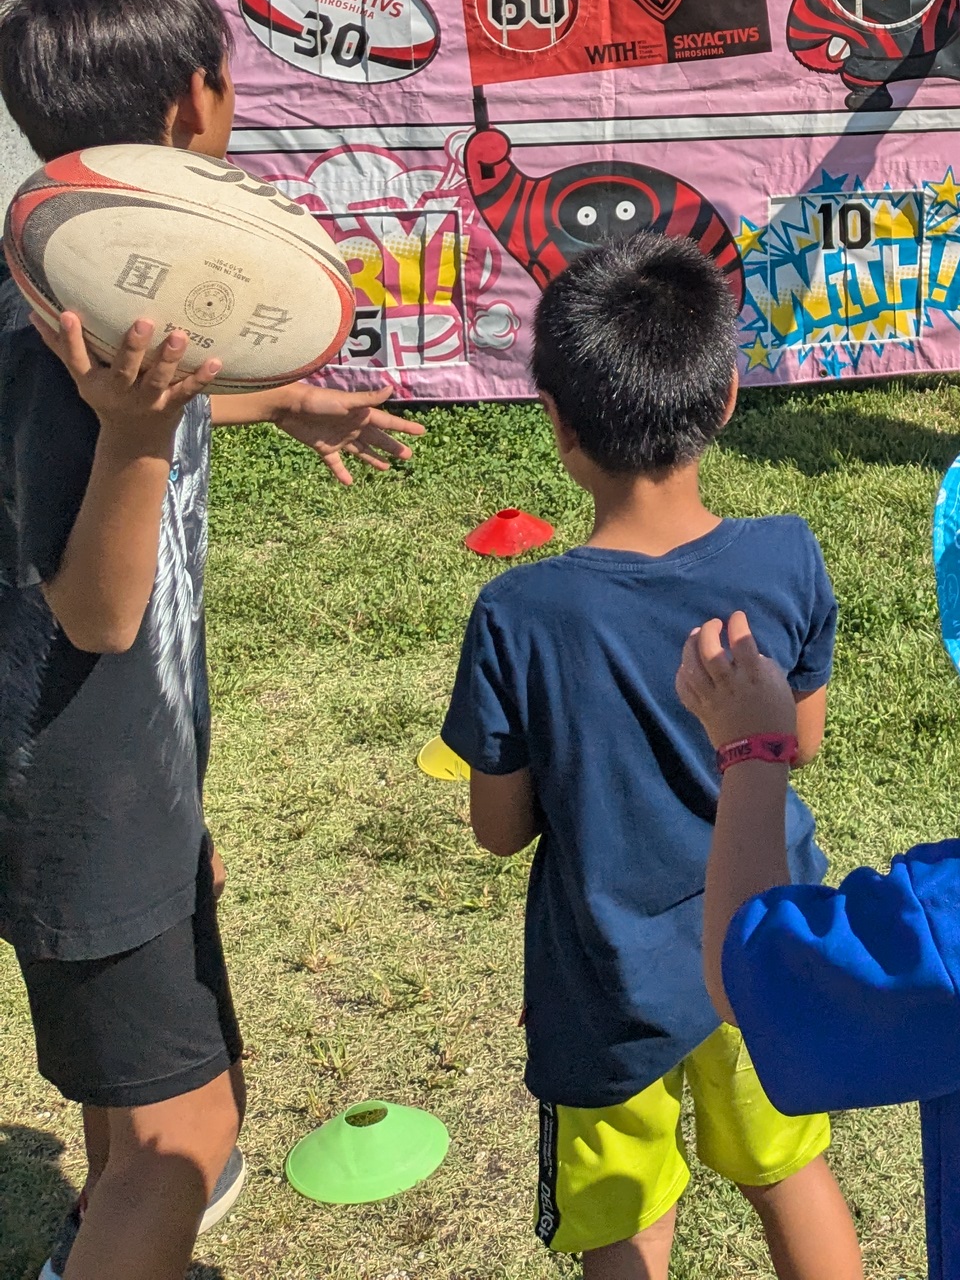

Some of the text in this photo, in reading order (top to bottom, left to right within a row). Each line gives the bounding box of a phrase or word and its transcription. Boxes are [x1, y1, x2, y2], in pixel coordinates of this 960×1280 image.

[294, 10, 370, 68] 30
[673, 27, 760, 50] SKYACTIVS
[584, 40, 638, 65] WITH
[675, 47, 724, 59] HIROSHIMA
[817, 202, 872, 250] 10
[204, 260, 223, 273] INDIA
[234, 272, 251, 283] MADE
[348, 309, 382, 358] 5
